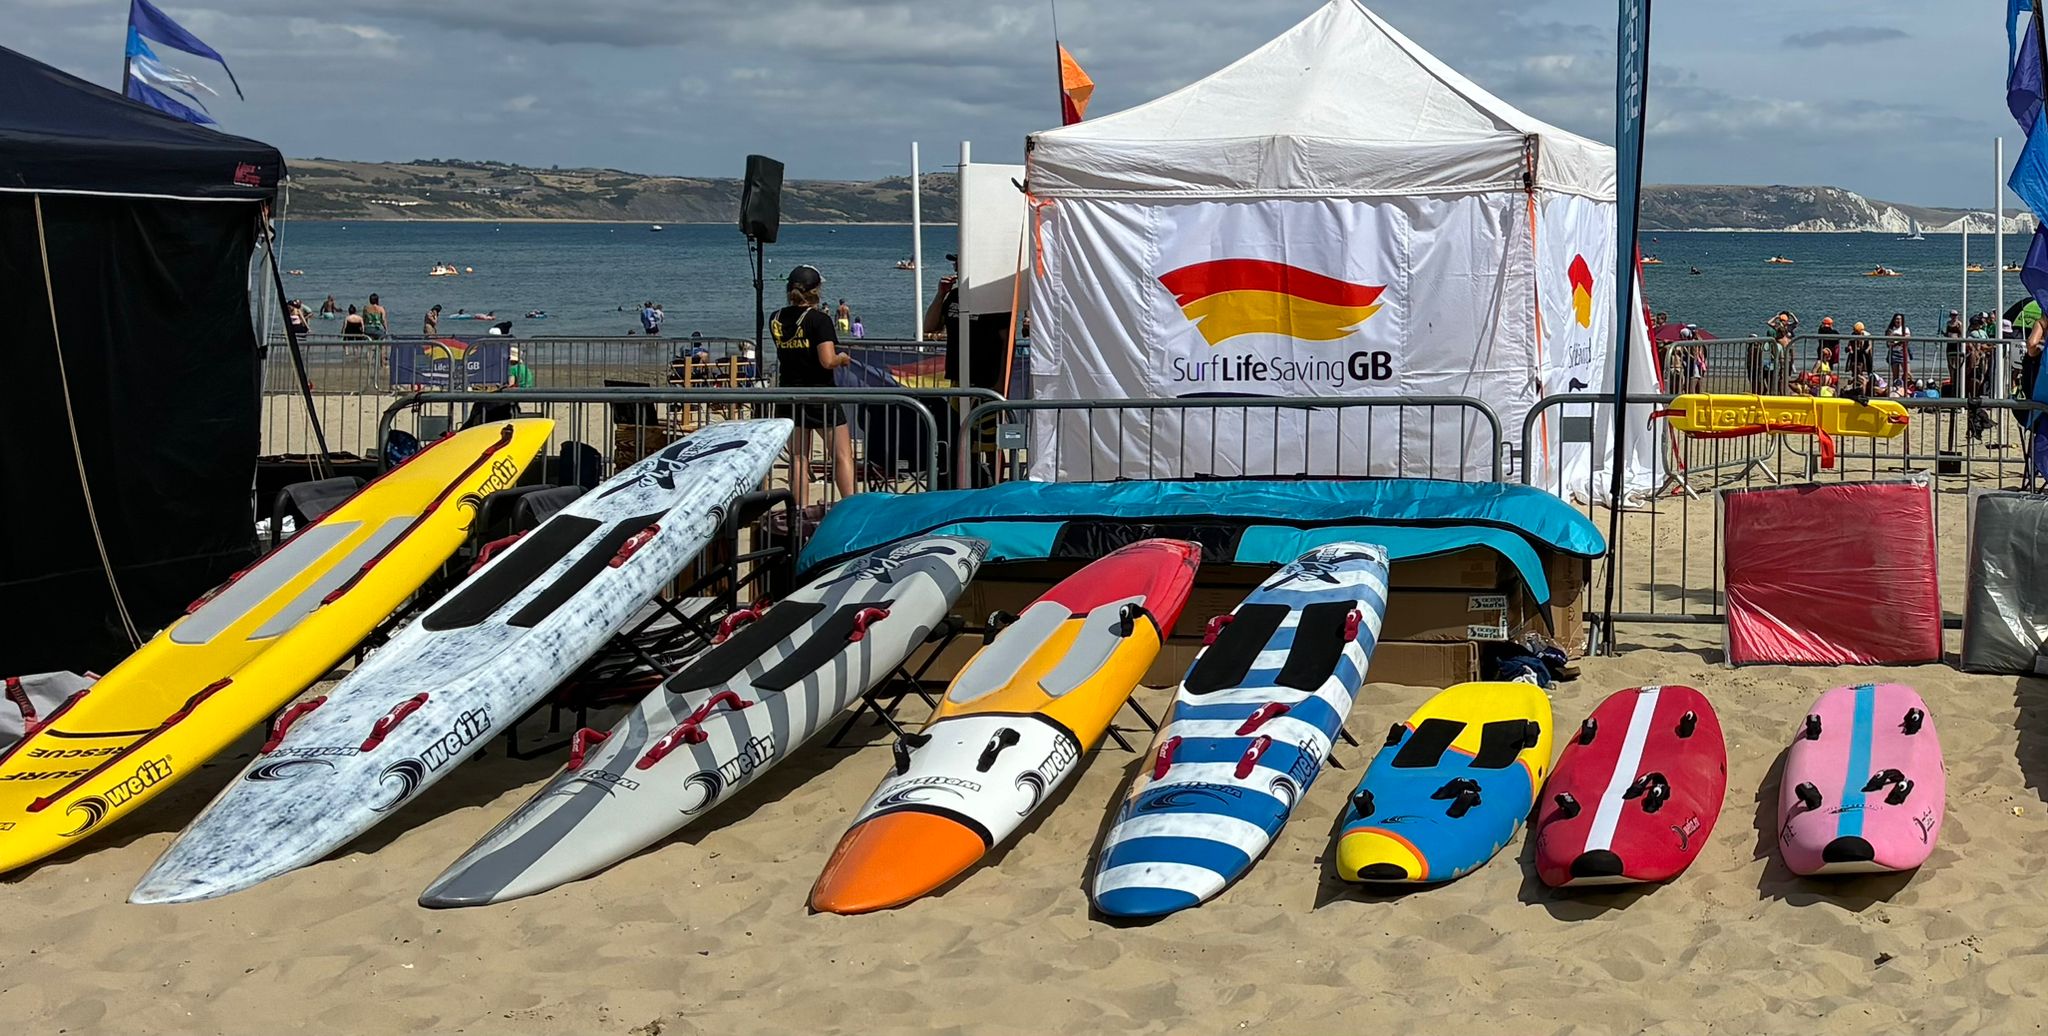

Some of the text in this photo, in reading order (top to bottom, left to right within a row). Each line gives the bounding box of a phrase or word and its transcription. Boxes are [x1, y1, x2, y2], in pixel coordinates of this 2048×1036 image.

[420, 707, 492, 773] wetiz
[718, 734, 776, 787] wetiz
[1287, 738, 1322, 790] wetiz
[104, 758, 173, 808] wetiz
